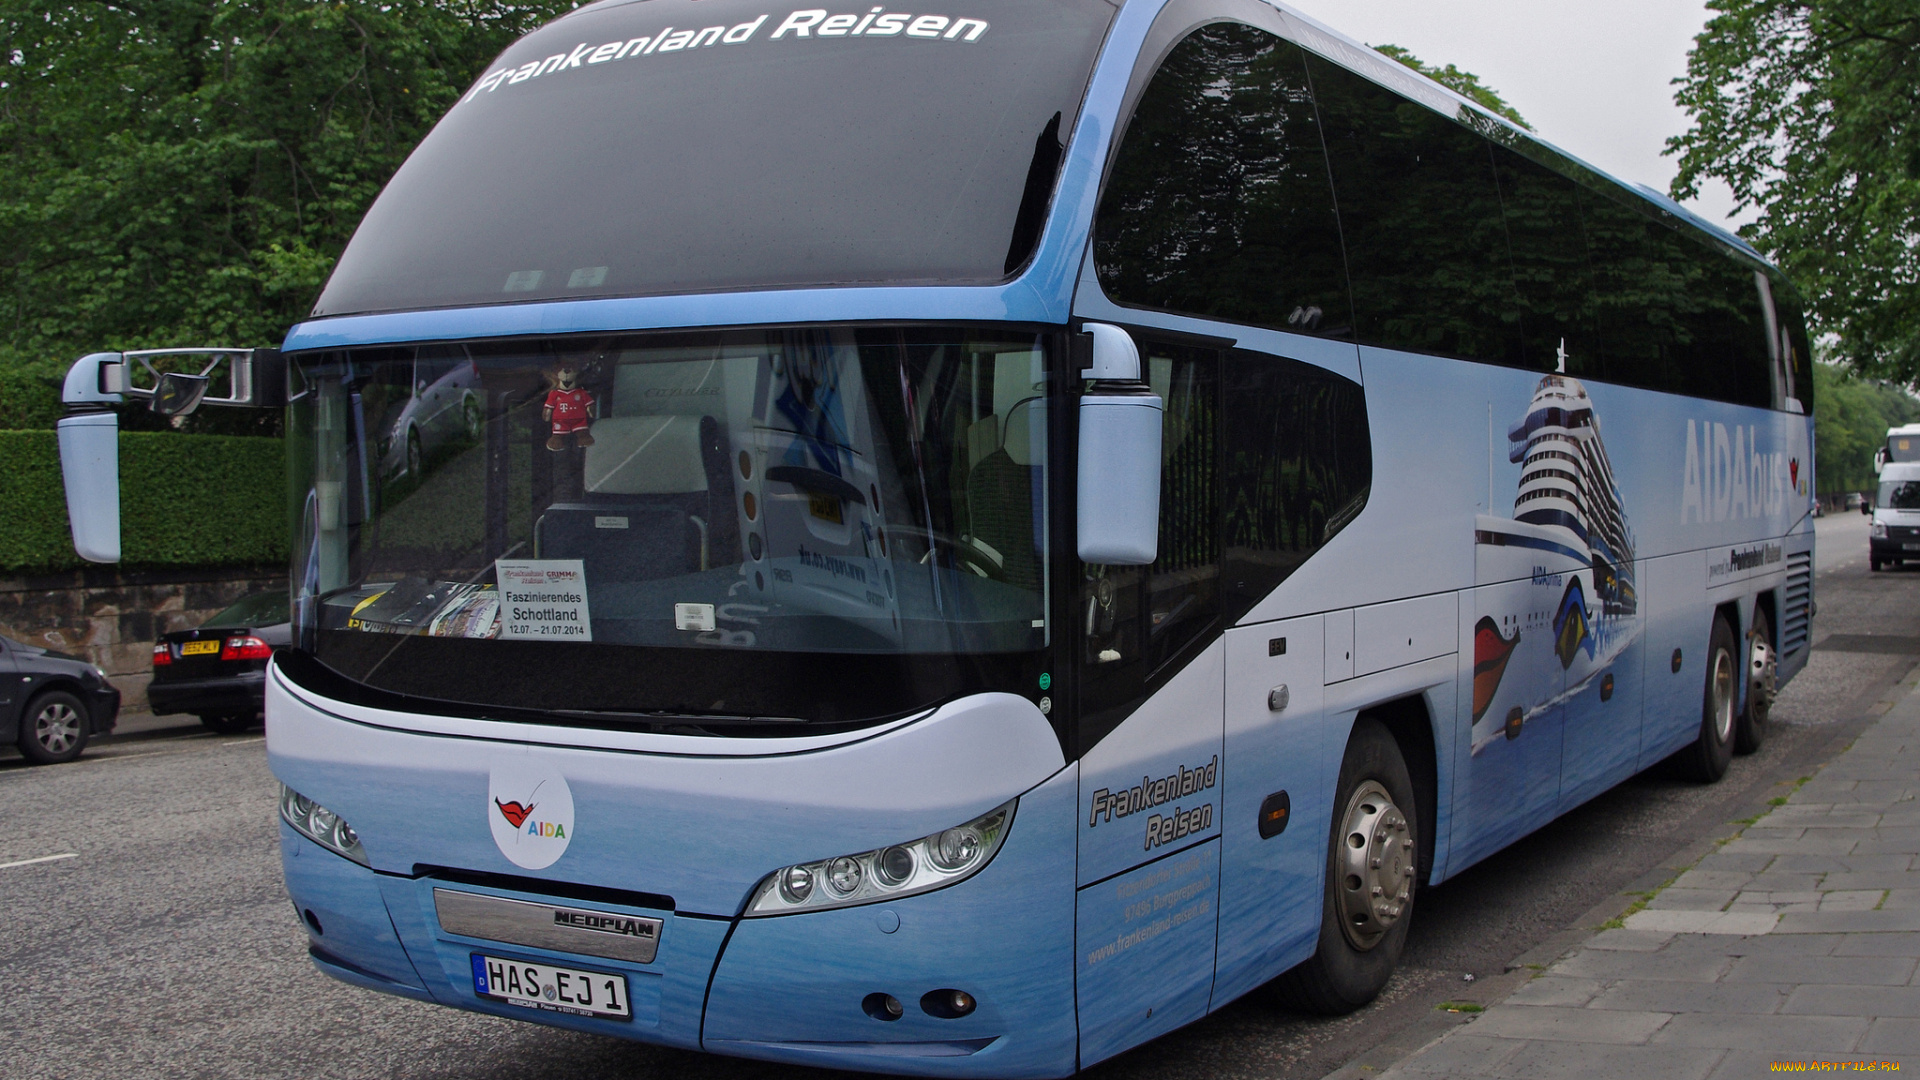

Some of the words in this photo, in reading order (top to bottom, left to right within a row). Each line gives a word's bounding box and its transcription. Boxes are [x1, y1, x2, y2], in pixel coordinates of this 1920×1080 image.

[464, 14, 770, 104] Frankenland
[771, 6, 989, 43] Reisen
[506, 591, 582, 603] Faszinierendes
[513, 607, 578, 621] Schottland
[509, 625, 532, 634] 12.07.
[540, 625, 584, 635] 21.07.2014
[1089, 754, 1218, 828] Frankenland
[528, 821, 566, 839] AIDA
[1144, 803, 1212, 851] Reisen
[555, 910, 654, 938] NEOPLAN
[478, 976, 486, 986] D
[488, 962, 540, 997] HAS
[556, 972, 593, 1006] EJ
[604, 980, 622, 1011] 1
